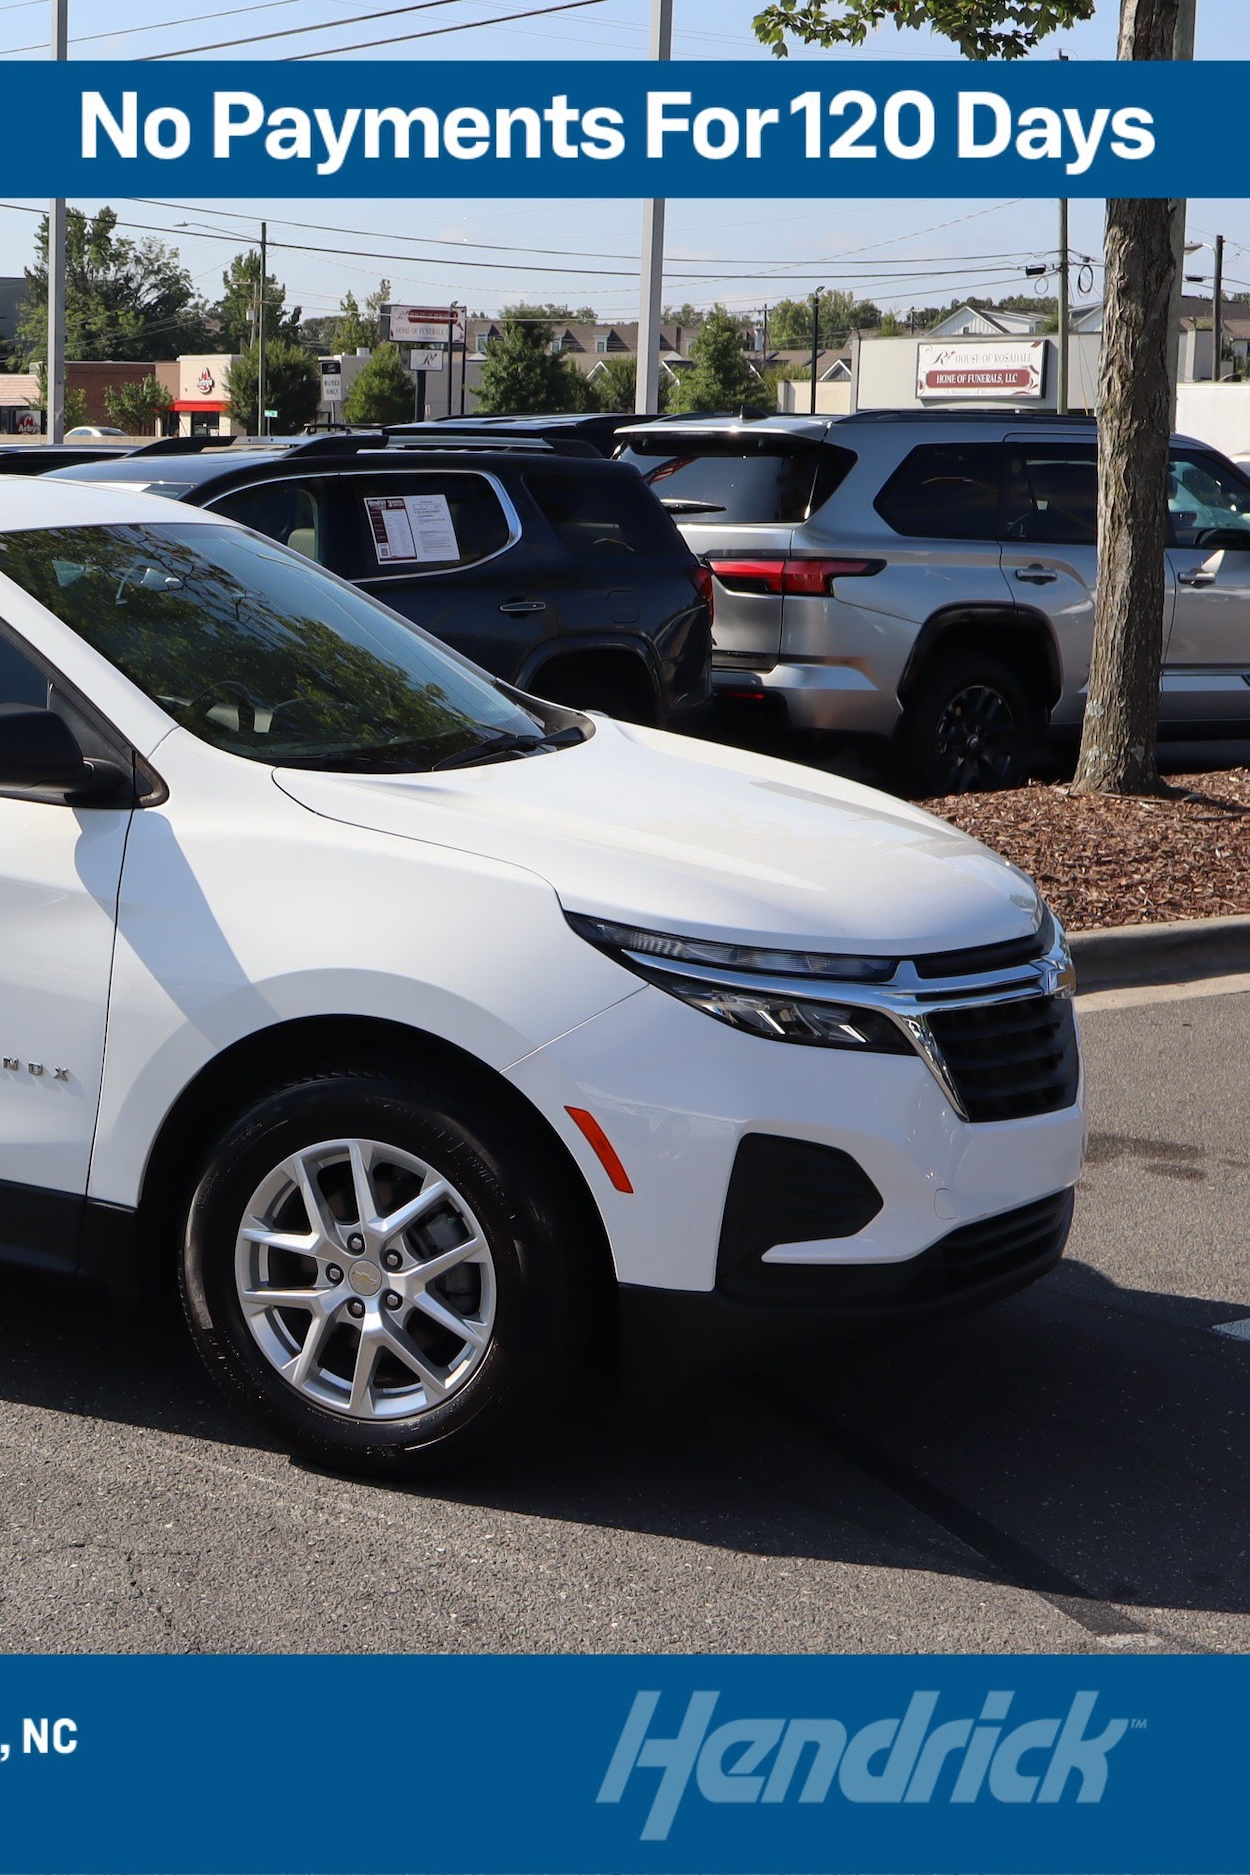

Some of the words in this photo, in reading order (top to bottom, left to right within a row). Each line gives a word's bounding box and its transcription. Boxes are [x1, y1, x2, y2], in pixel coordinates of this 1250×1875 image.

[955, 354, 978, 363] HOUSE
[981, 354, 991, 363] OF
[936, 374, 957, 384] HOME
[957, 374, 967, 384] OF
[967, 373, 1004, 384] FUNERALS,
[1005, 373, 1018, 383] LLC
